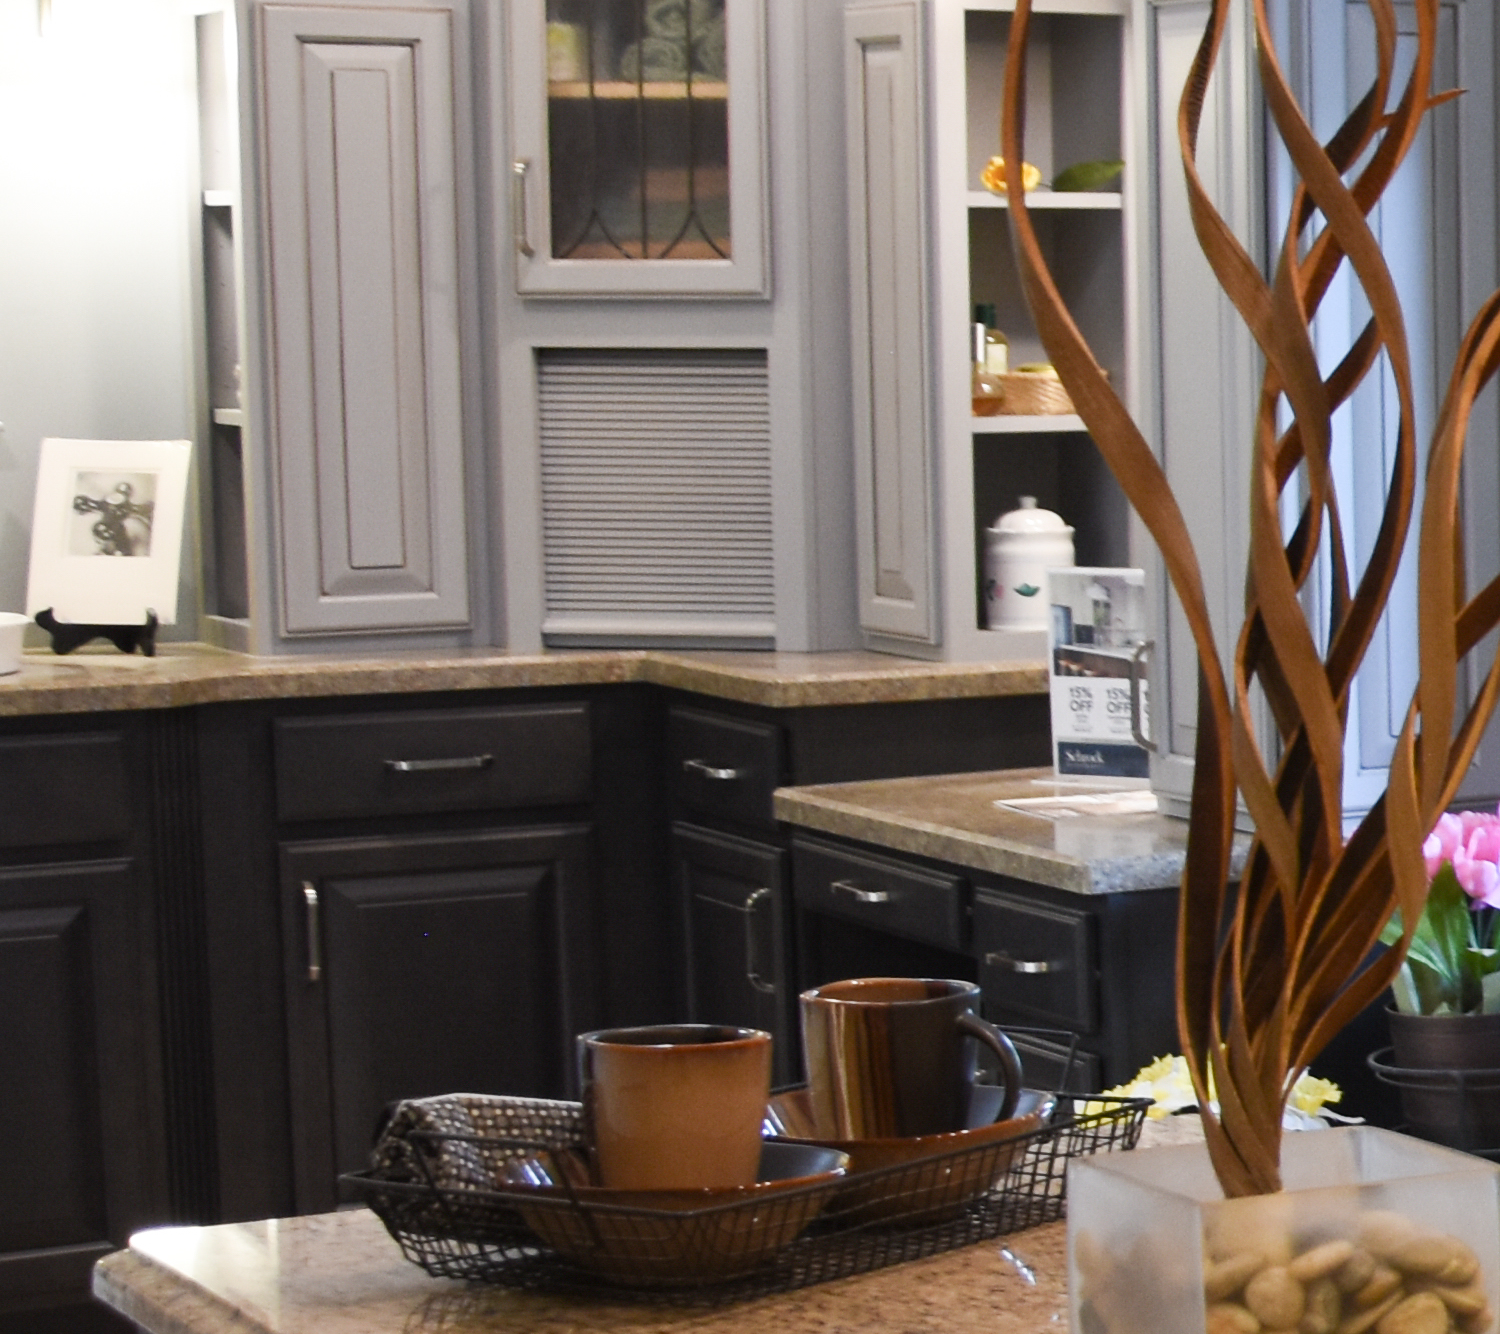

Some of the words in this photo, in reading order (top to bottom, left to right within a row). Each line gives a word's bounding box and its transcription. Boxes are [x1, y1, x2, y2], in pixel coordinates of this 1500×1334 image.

[1069, 686, 1093, 699] 15%
[1070, 699, 1093, 712] OFF
[1107, 701, 1131, 714] OFF
